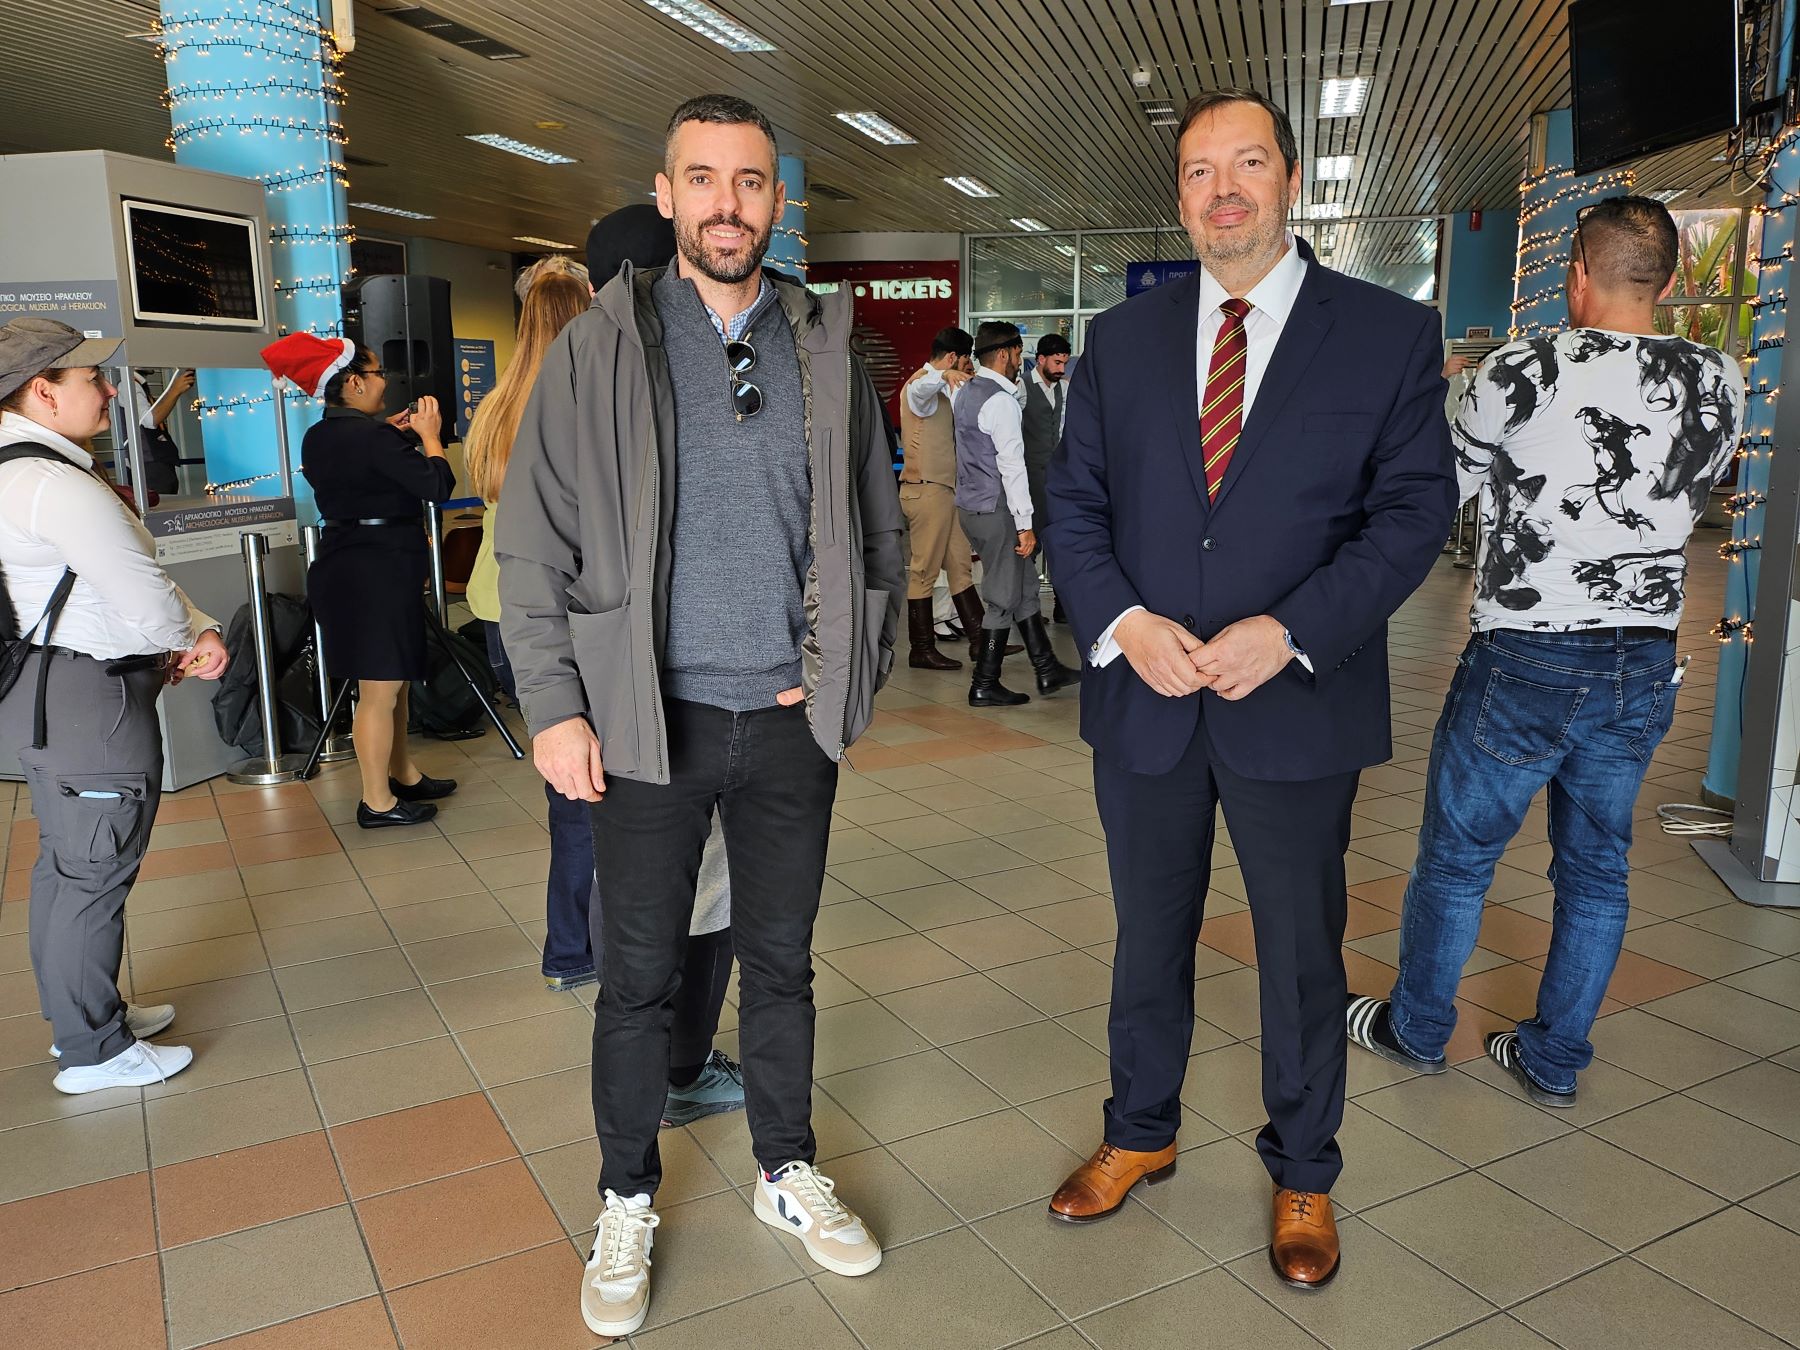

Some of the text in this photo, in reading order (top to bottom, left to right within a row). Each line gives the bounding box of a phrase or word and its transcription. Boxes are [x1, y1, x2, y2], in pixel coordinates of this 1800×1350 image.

[20, 292, 52, 302] ΜΟΥΣΕΙΟ
[54, 292, 92, 301] ΗΡΑΚΛΕΙΟΥ
[869, 279, 952, 300] TICKETS
[29, 303, 59, 311] MUSEUM
[69, 301, 106, 311] HERAKLION
[184, 504, 275, 521] ΑΡΧΑΙΟΛΟΓΙΚΟ ΜΟΥΣΕΙΟ ΗΡΑΚΛΕΙΟΥ
[185, 517, 230, 529] ARCHAEOLOGICAL
[231, 514, 252, 523] MUSEUM
